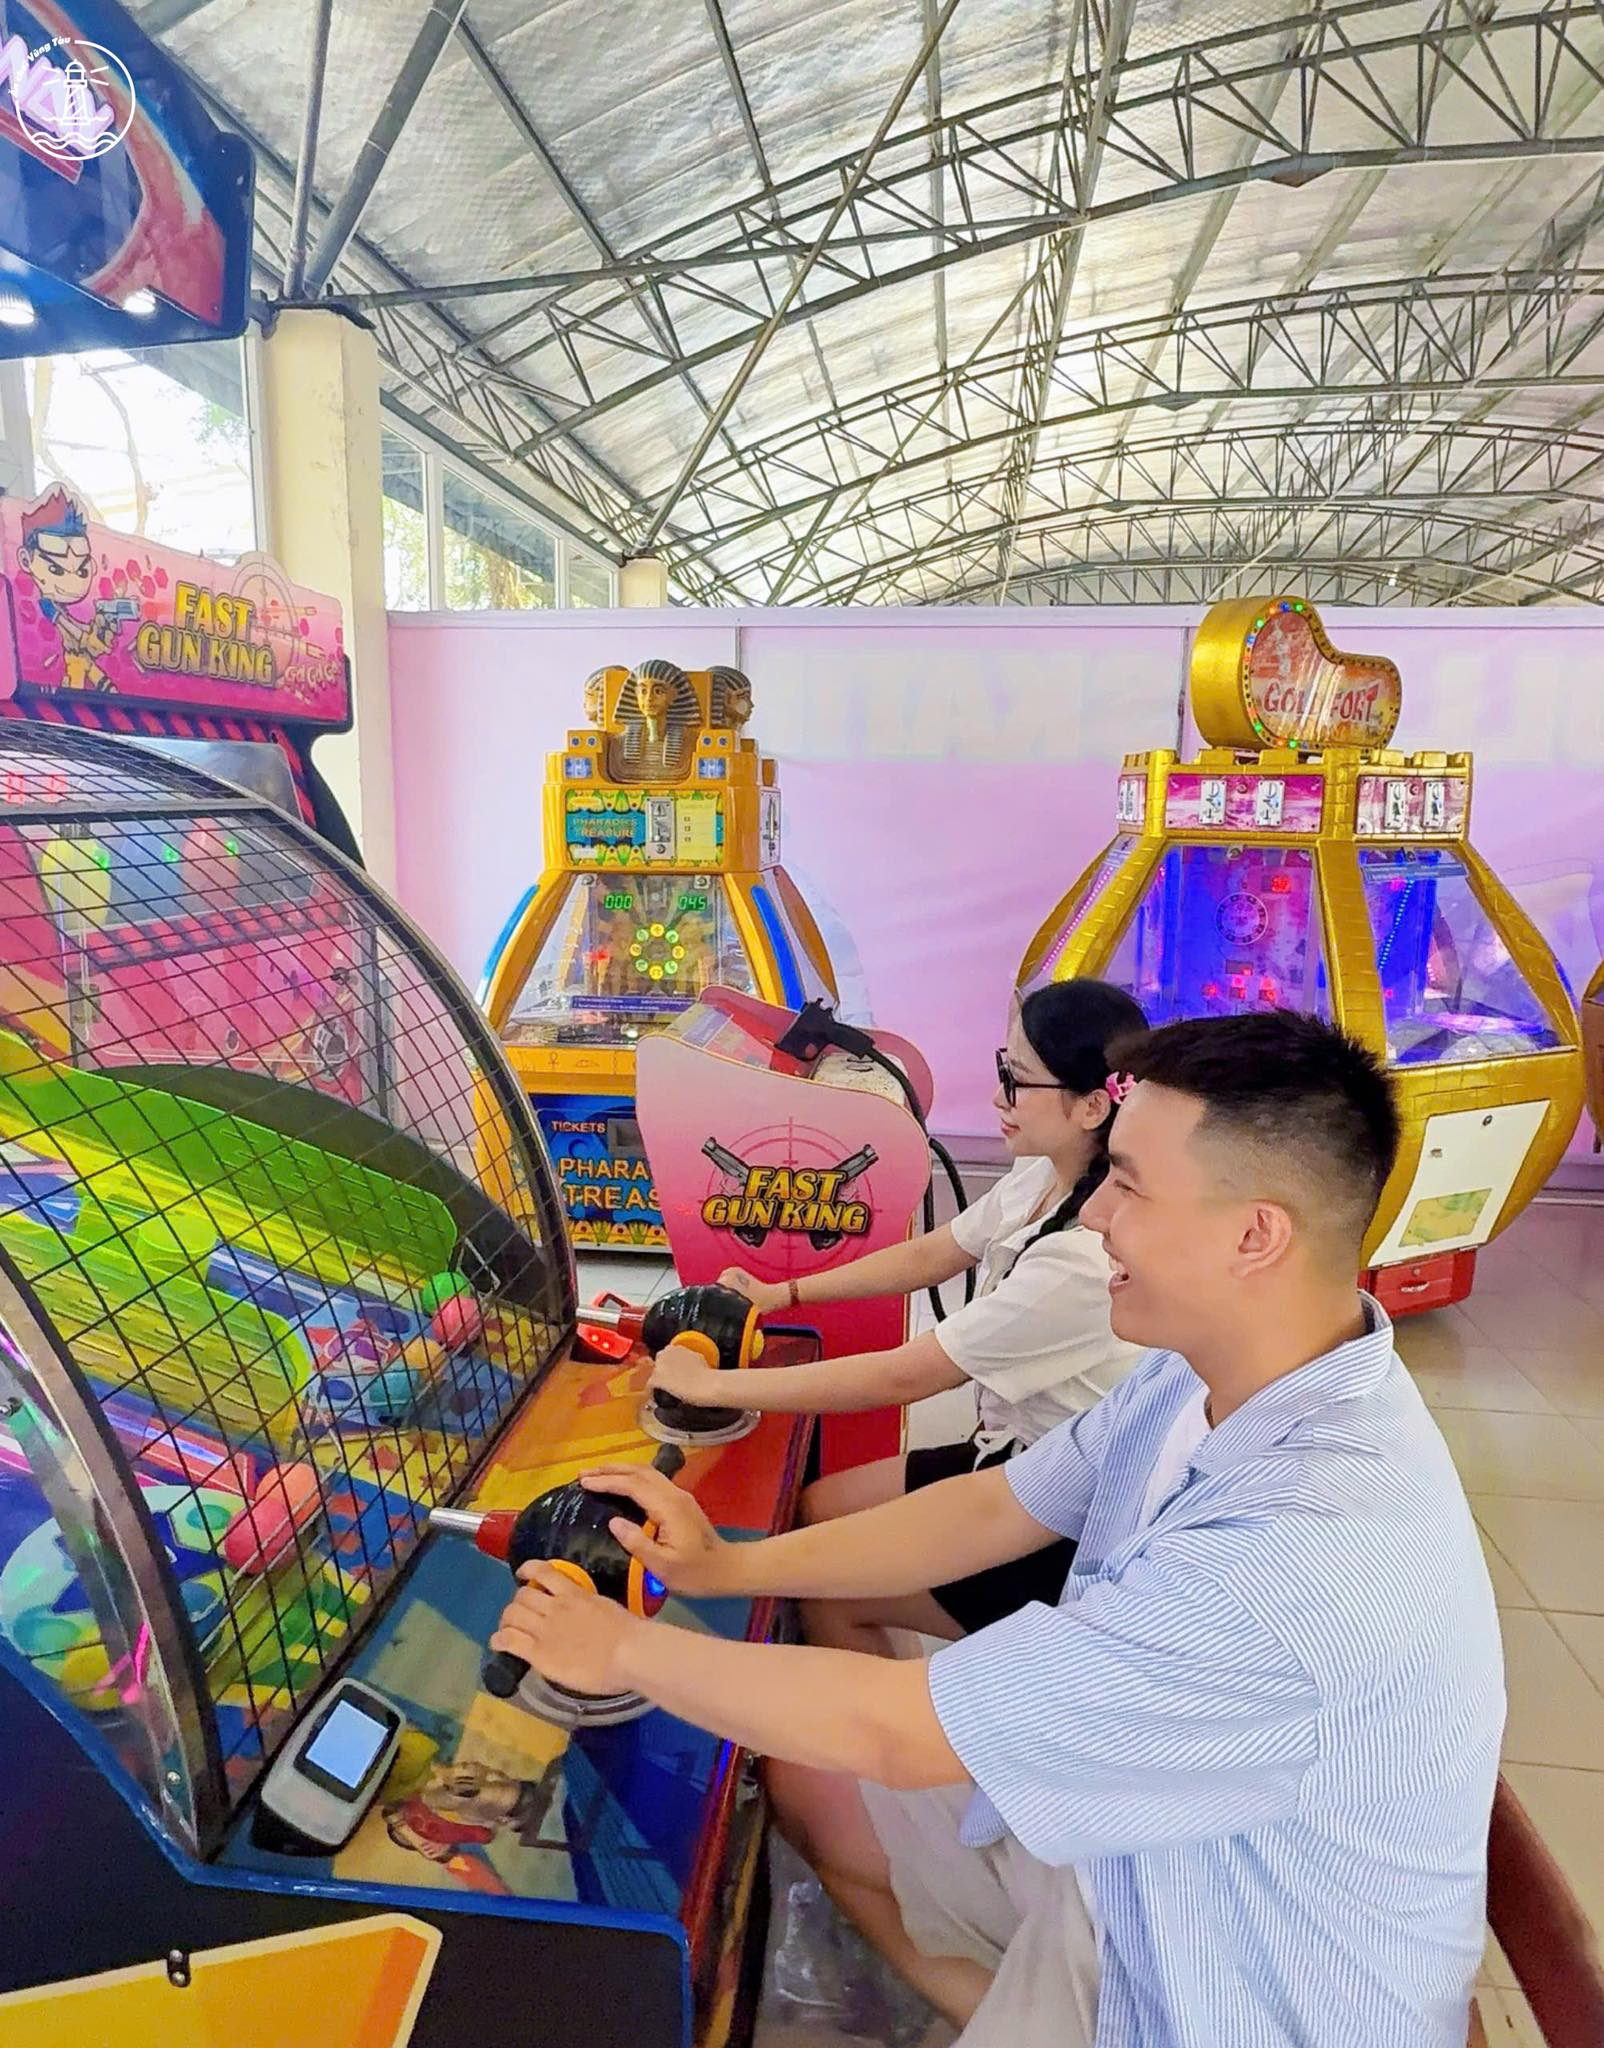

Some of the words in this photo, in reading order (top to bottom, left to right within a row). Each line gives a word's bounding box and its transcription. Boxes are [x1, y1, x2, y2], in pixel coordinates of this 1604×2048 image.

[176, 581, 255, 642] FAST
[137, 621, 202, 676] GUN
[208, 636, 273, 687] KING
[1330, 683, 1379, 722] FORT
[604, 894, 633, 910] 000
[679, 895, 707, 910] 045
[552, 1120, 606, 1134] TICKETS
[747, 1167, 843, 1203] FAST
[702, 1198, 775, 1228] GUN
[779, 1201, 867, 1233] KING
